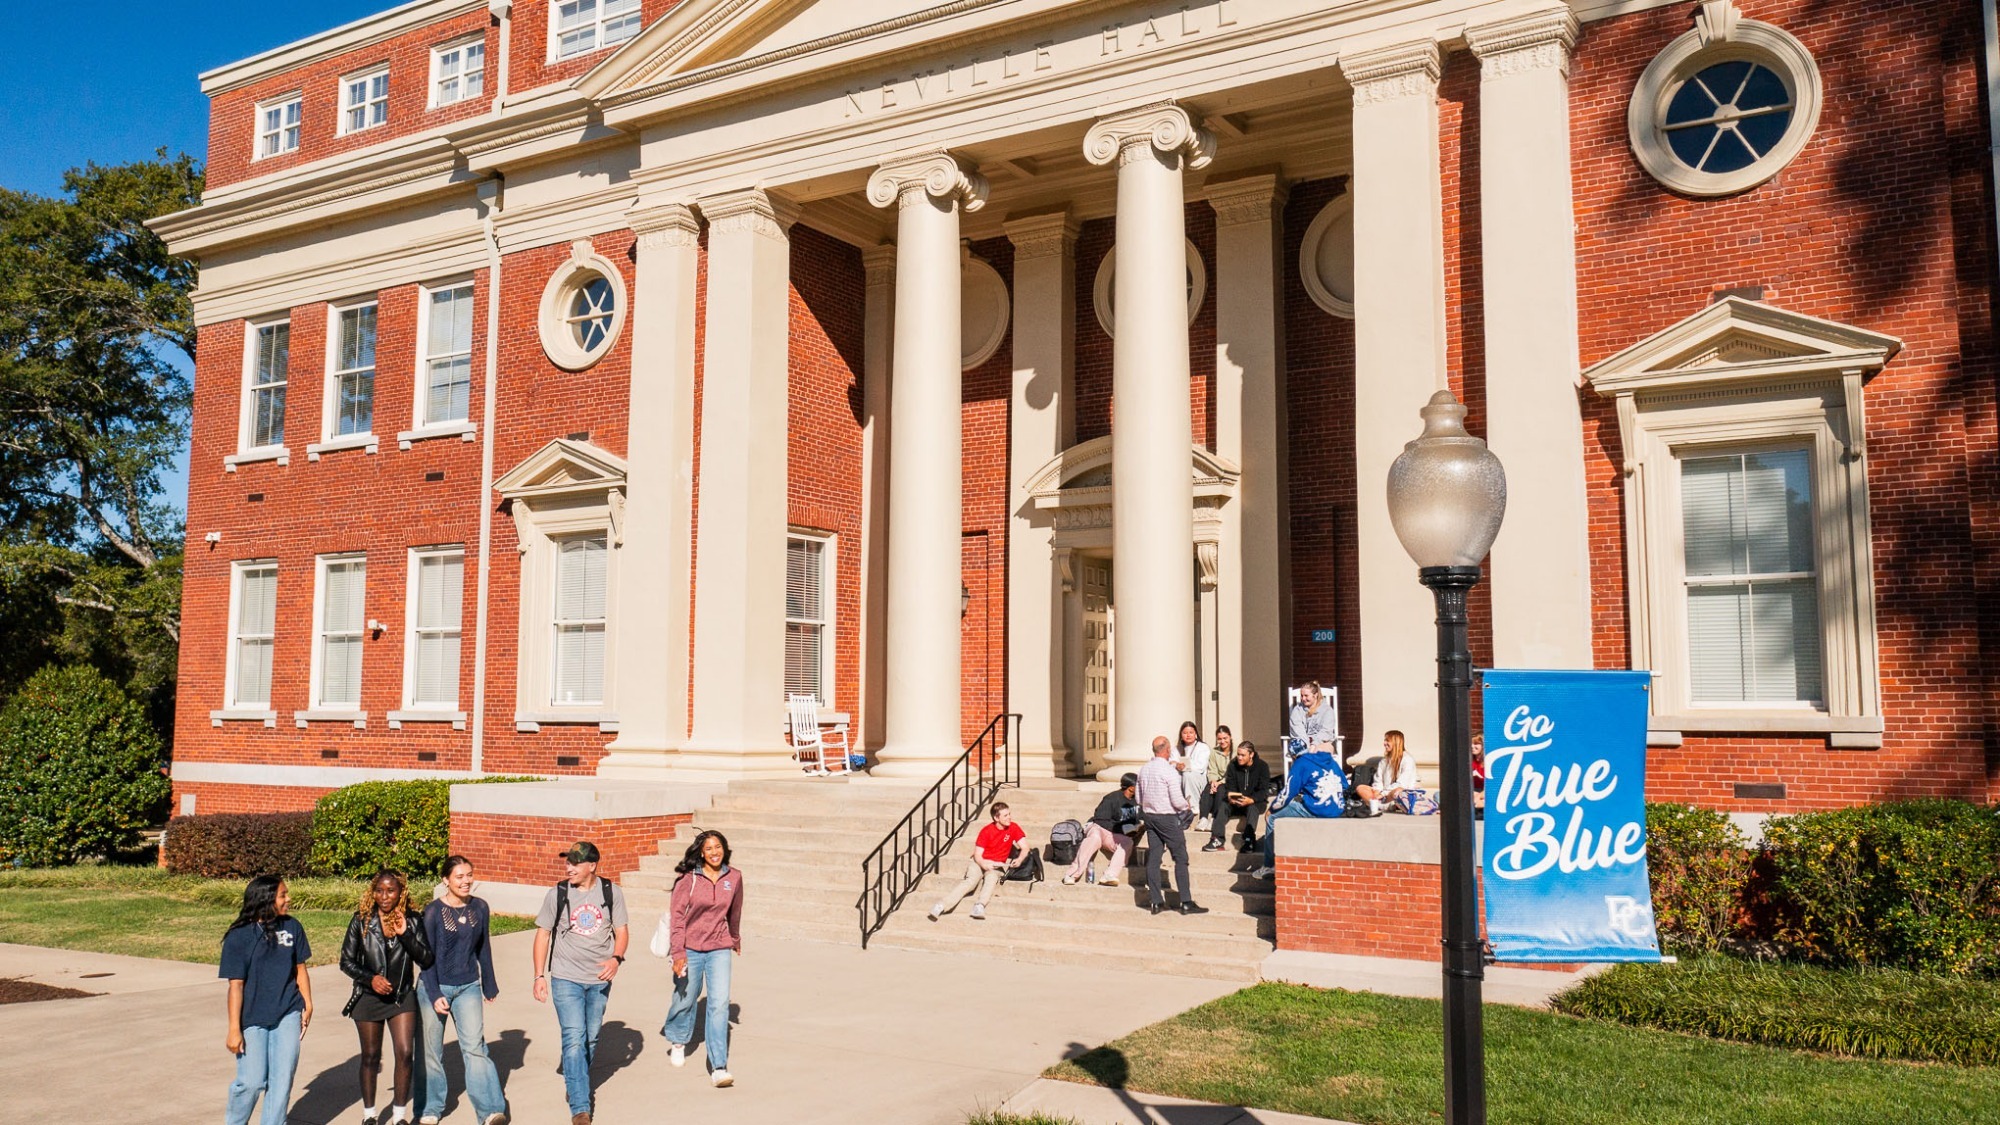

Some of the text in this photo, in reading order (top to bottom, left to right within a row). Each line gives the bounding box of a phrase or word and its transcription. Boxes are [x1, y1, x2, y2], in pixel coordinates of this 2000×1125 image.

[845, 0, 1237, 117] NEVILLE HALL
[1315, 631, 1333, 641] 200
[1503, 704, 1555, 742] Go
[1485, 738, 1618, 814] True
[1492, 805, 1647, 881] Blue
[275, 929, 294, 947] PC
[1604, 895, 1651, 938] PC
